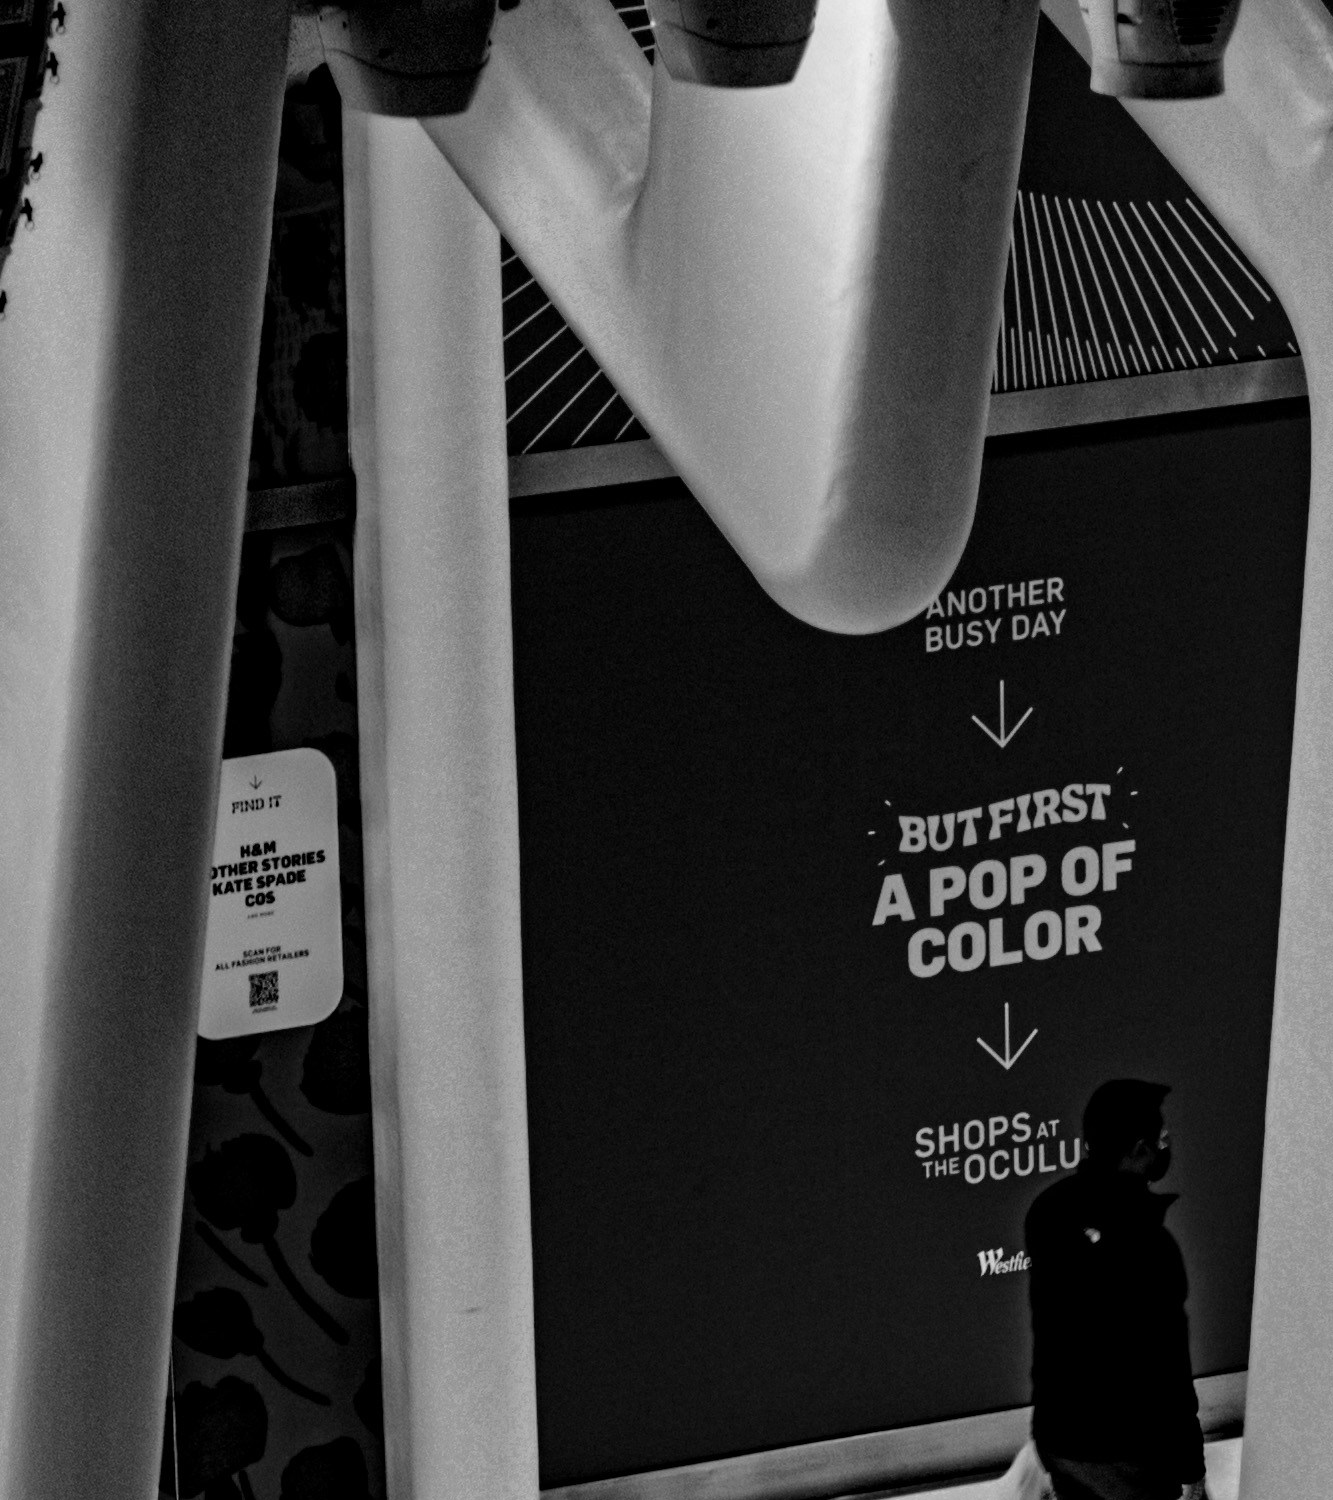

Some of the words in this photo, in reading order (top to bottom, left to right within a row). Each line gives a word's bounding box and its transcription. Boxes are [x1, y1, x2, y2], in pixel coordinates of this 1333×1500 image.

[925, 577, 1064, 620] ANOTHER
[925, 618, 1002, 653] BUSY
[1011, 609, 1067, 641] DAY
[232, 798, 265, 814] FIND
[269, 795, 282, 808] IT
[898, 806, 983, 853] BUT
[988, 783, 1111, 840] FIRST
[240, 841, 276, 858] H&M
[261, 850, 326, 871] STORIES
[212, 878, 253, 896] KATE
[256, 869, 306, 889] SPADE
[872, 874, 915, 926] A
[929, 853, 1047, 917] POP
[1060, 839, 1136, 897] OF
[245, 891, 276, 907] COS
[243, 948, 264, 958] SCAN
[266, 945, 281, 954] FOR
[907, 904, 1103, 979] COLOR
[215, 963, 229, 971] ALL
[231, 957, 265, 968] FASHION
[267, 949, 310, 962] RETAILERS
[914, 1111, 1031, 1158] SHOPS
[1036, 1119, 1060, 1139] AT
[922, 1157, 960, 1179] THE
[964, 1137, 1081, 1185] OCULU
[977, 1246, 1032, 1277] Westfie
